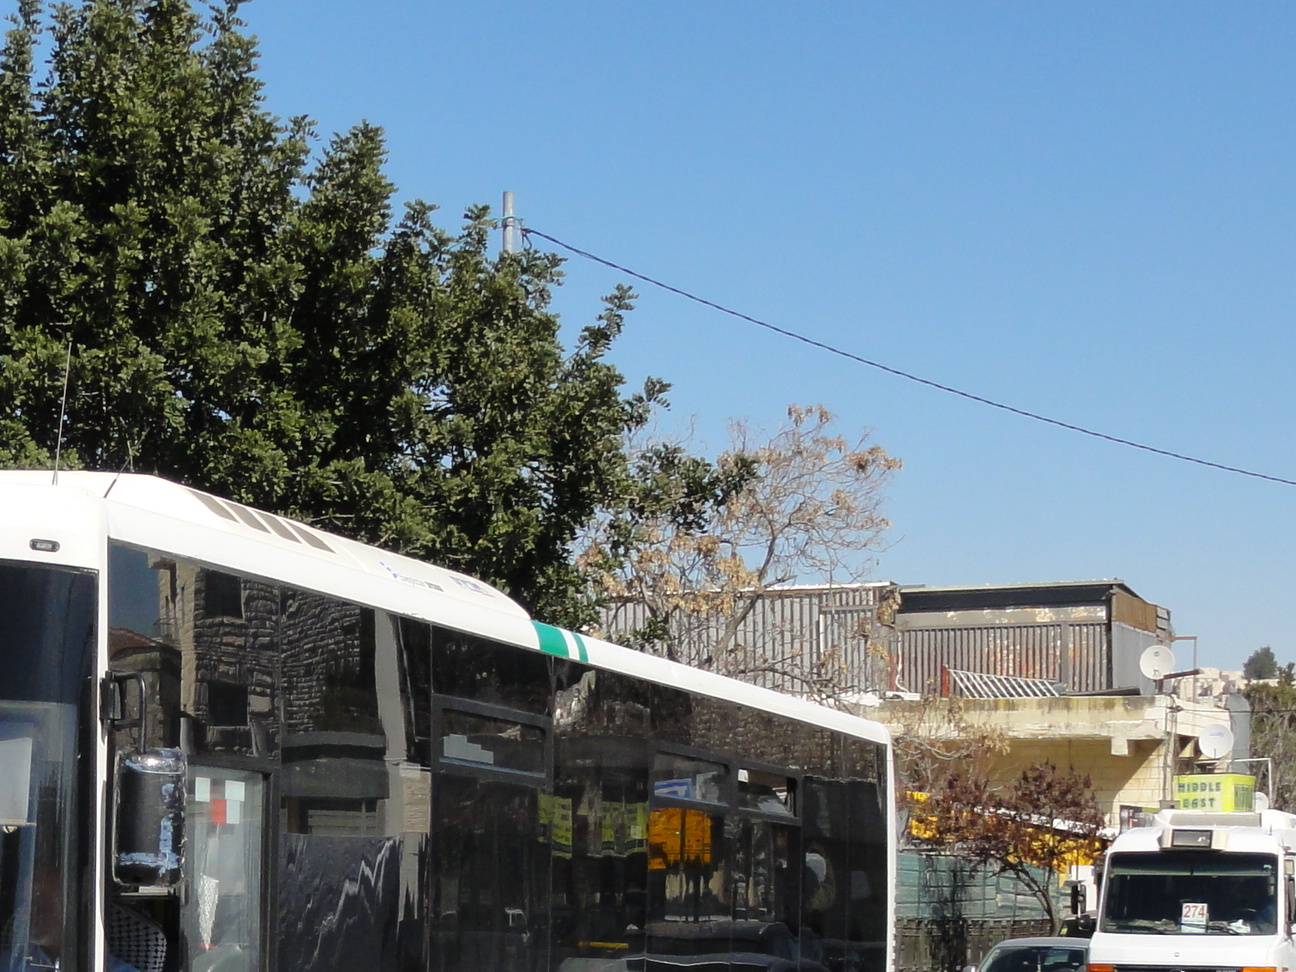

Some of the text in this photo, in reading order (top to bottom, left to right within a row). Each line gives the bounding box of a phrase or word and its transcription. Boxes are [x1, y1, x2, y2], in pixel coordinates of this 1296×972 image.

[1178, 782, 1222, 793] MIDDLE
[1183, 797, 1215, 808] EAST
[1184, 905, 1206, 918] 274
